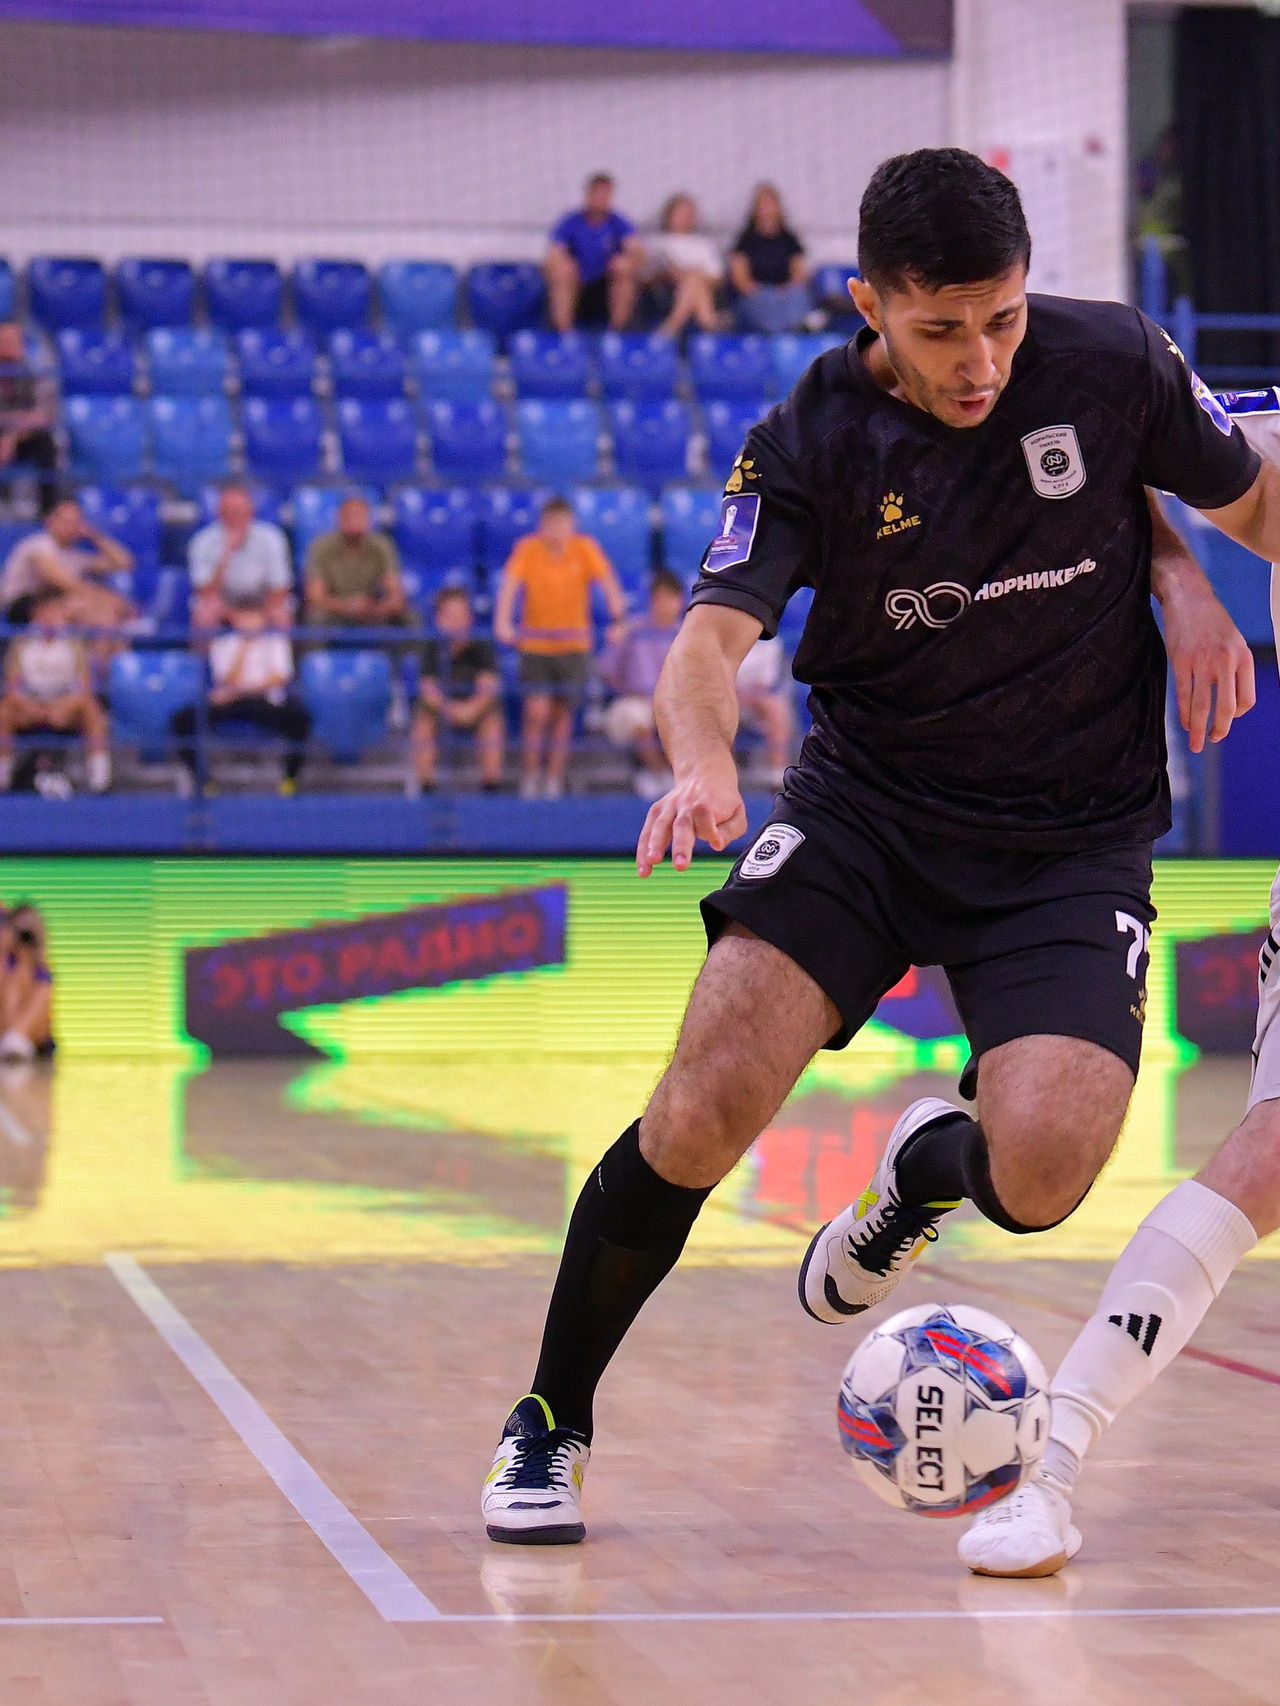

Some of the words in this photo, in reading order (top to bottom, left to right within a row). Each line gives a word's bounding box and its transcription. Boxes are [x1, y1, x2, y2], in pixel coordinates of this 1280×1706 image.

[876, 515, 921, 540] KELME
[212, 953, 325, 1010] ЭТО
[916, 1385, 944, 1492] SELECT
